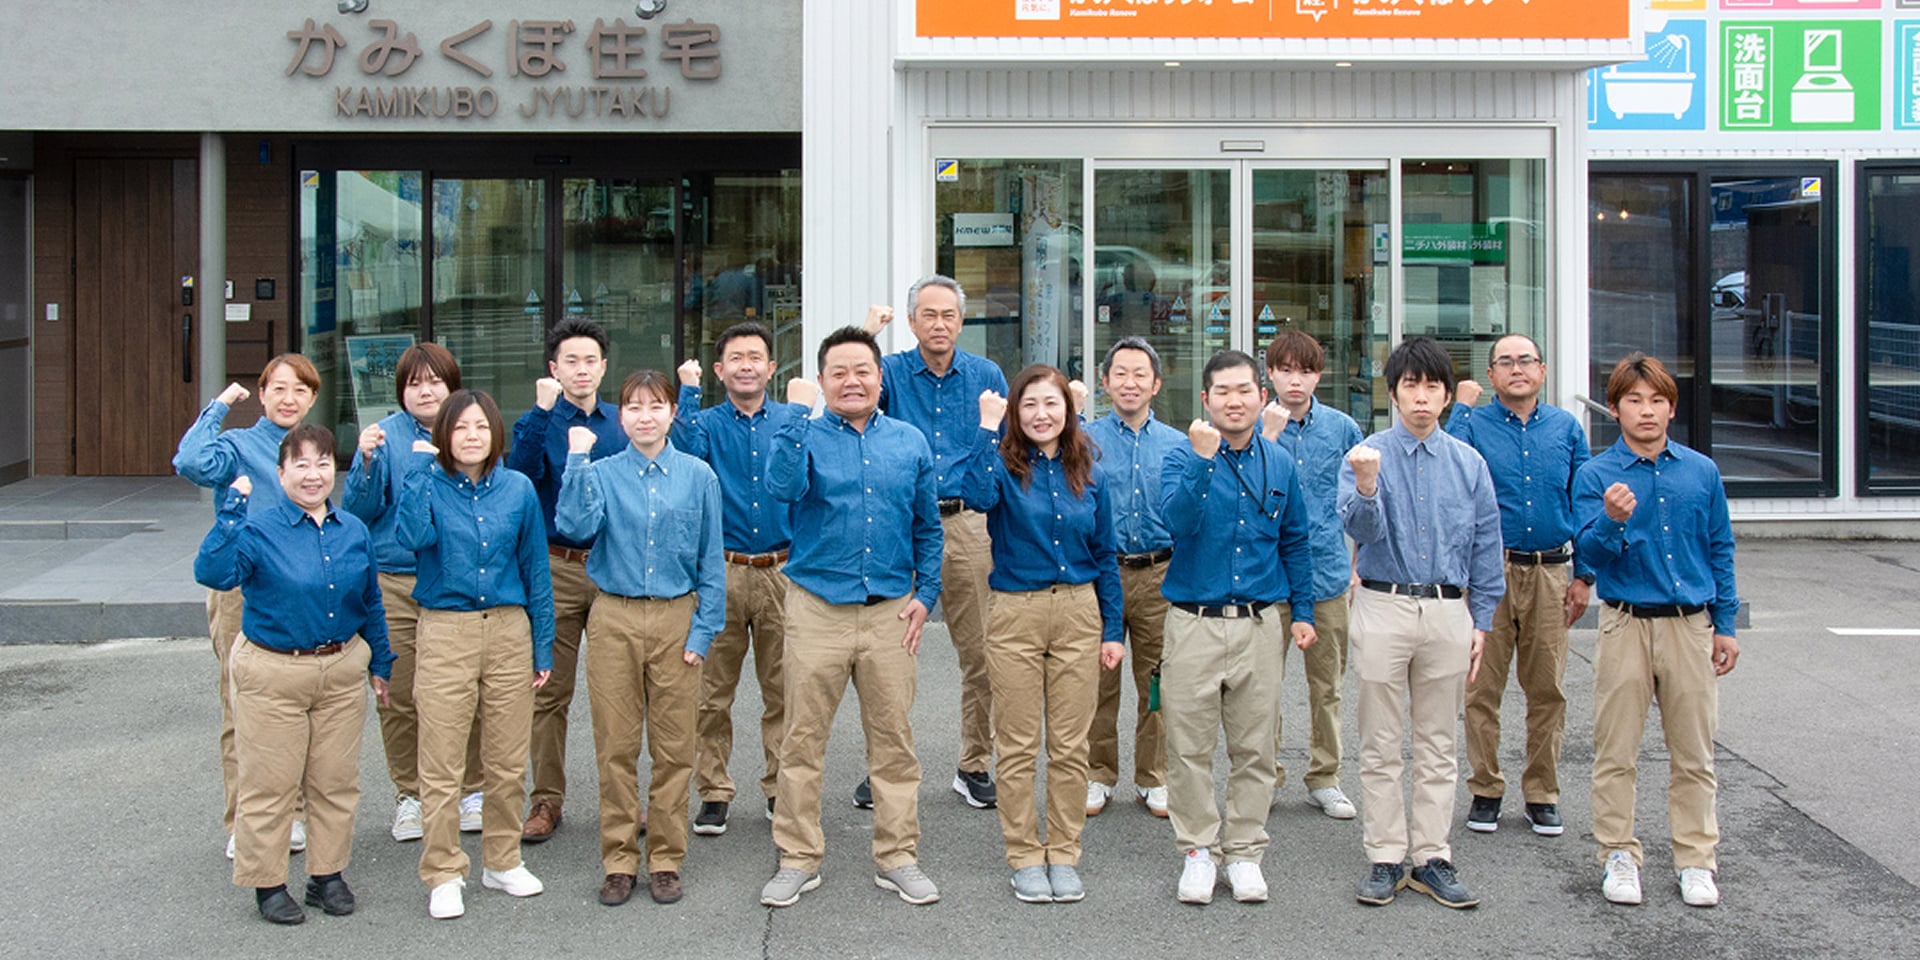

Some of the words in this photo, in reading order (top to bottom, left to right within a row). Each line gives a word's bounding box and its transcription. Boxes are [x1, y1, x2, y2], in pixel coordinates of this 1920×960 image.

[285, 17, 722, 80] かみくぼ住宅
[1733, 32, 1766, 120] 洗面台
[334, 85, 499, 119] KAMIKUBO
[518, 85, 672, 119] JYUTAKU
